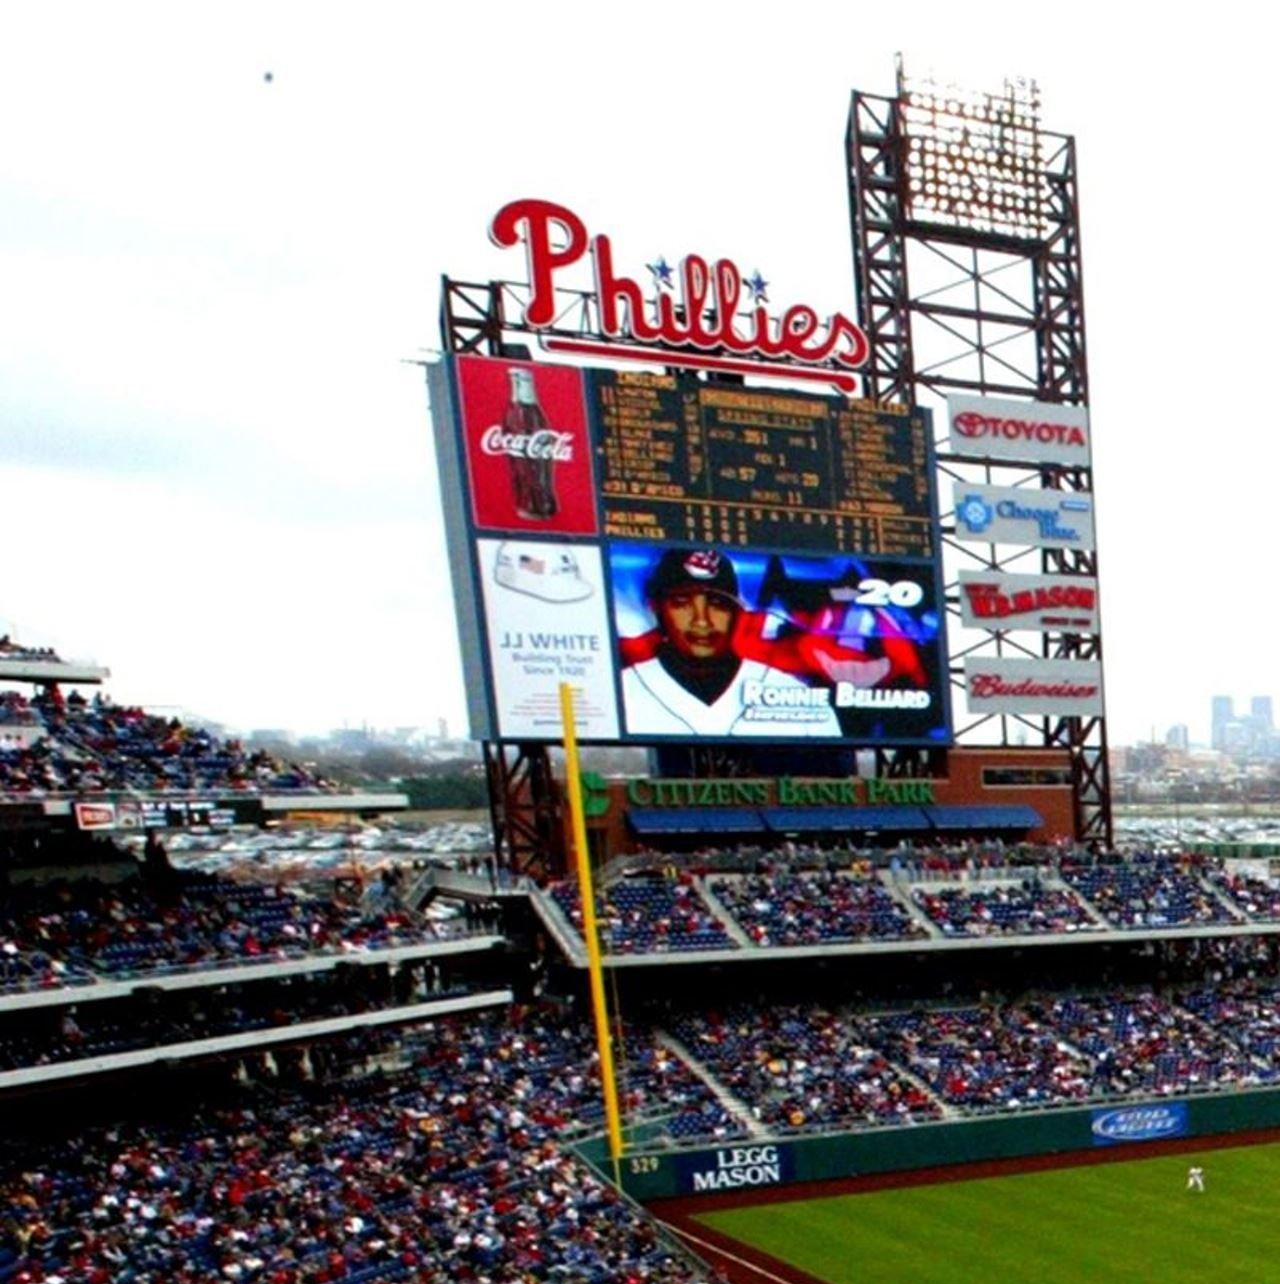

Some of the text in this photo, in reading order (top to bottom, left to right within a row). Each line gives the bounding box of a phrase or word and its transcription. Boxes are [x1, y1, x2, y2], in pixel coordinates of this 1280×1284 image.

[488, 199, 870, 368] Phillies
[481, 424, 575, 462] Coca-Cola
[987, 417, 1085, 446] TOYOTA
[854, 578, 924, 607] 20
[528, 632, 601, 652] WHITE
[835, 679, 932, 709] BELLIARD
[969, 673, 1098, 699] Budweiser
[627, 776, 936, 806] CITIZENS BANK PARK
[716, 1145, 779, 1169] LEGG
[692, 1163, 781, 1192] MASON
